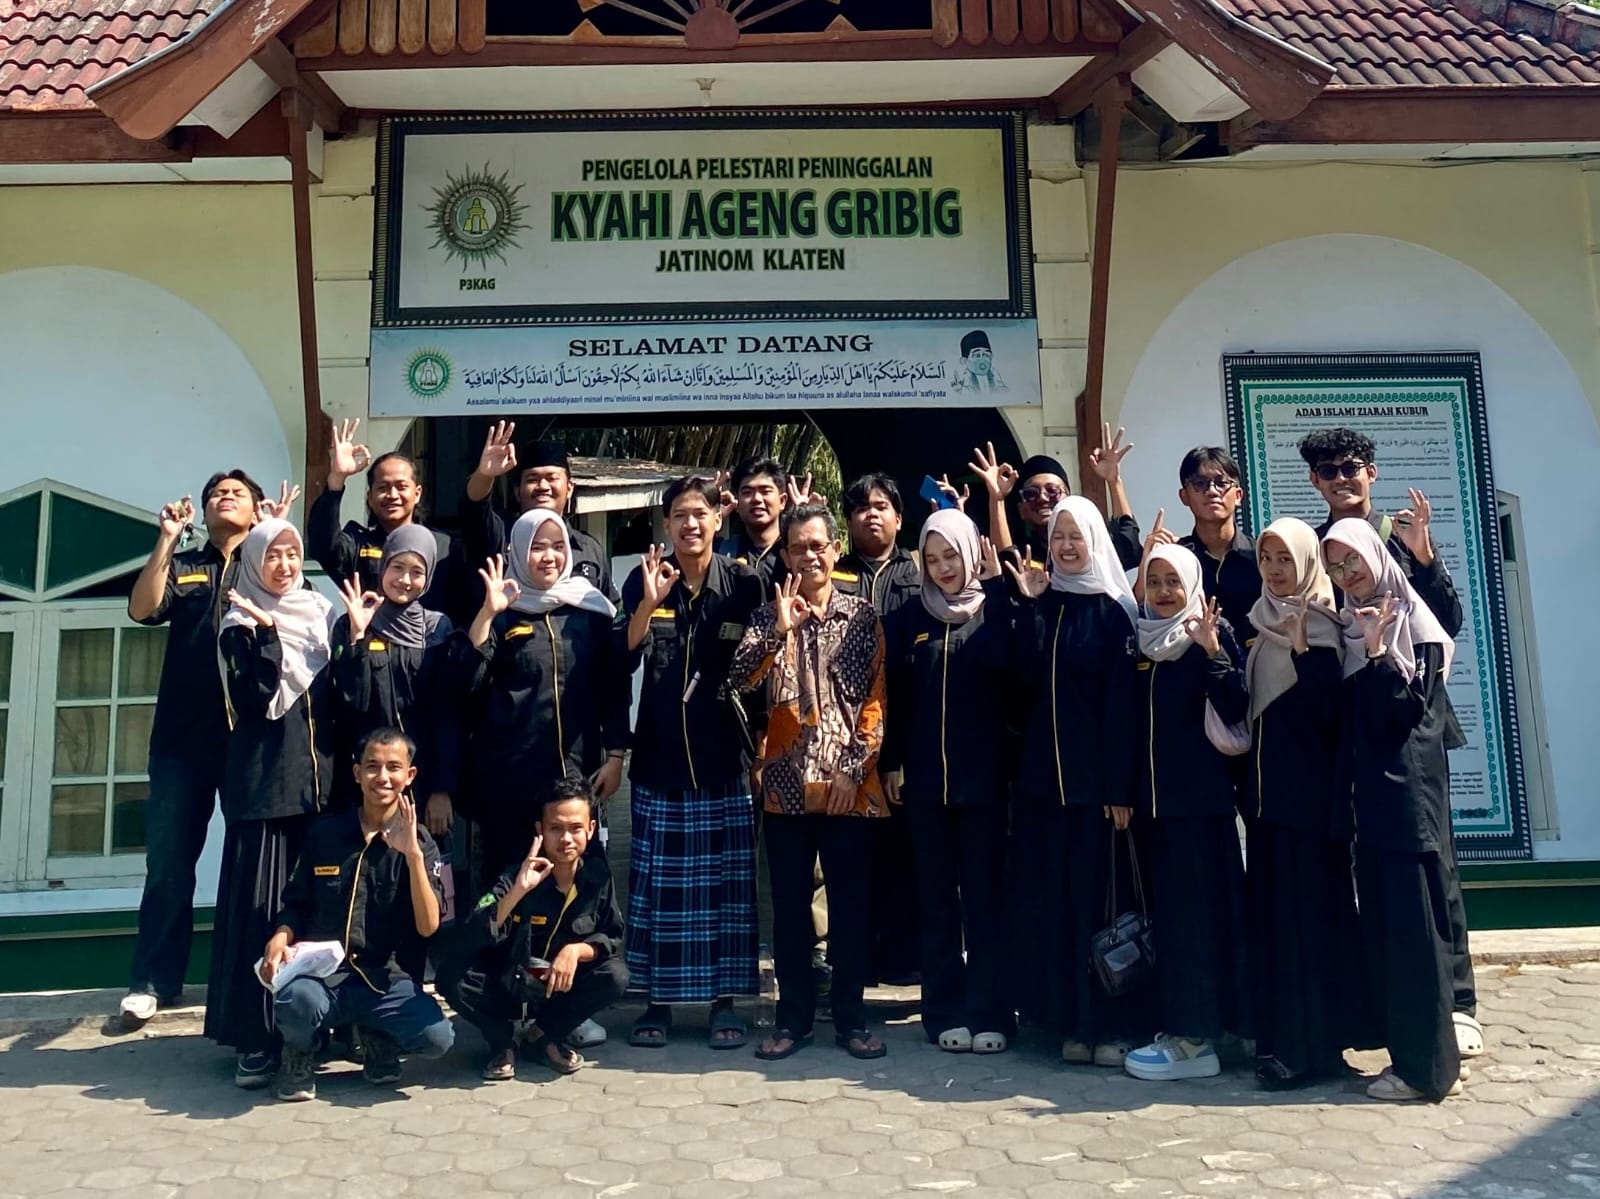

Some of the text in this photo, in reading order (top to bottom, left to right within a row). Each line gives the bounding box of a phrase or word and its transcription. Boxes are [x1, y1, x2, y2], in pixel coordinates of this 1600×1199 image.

[582, 156, 932, 181] PENGELOLA PELESTARI PENINGGALAN
[551, 189, 672, 242] KYAHI
[678, 188, 818, 240] AGENG
[824, 187, 963, 239] GRIBIG
[655, 248, 845, 273] JATINOM KLATEN
[459, 278, 496, 290] P3KAG
[569, 334, 874, 357] SELAMAT DATANG
[528, 397, 541, 406] yaa
[642, 393, 653, 402] wal
[742, 392, 764, 400] Allahu
[765, 392, 785, 400] bikum
[1295, 406, 1429, 417] ADAB ISLAMI ZIARAH KUBUR
